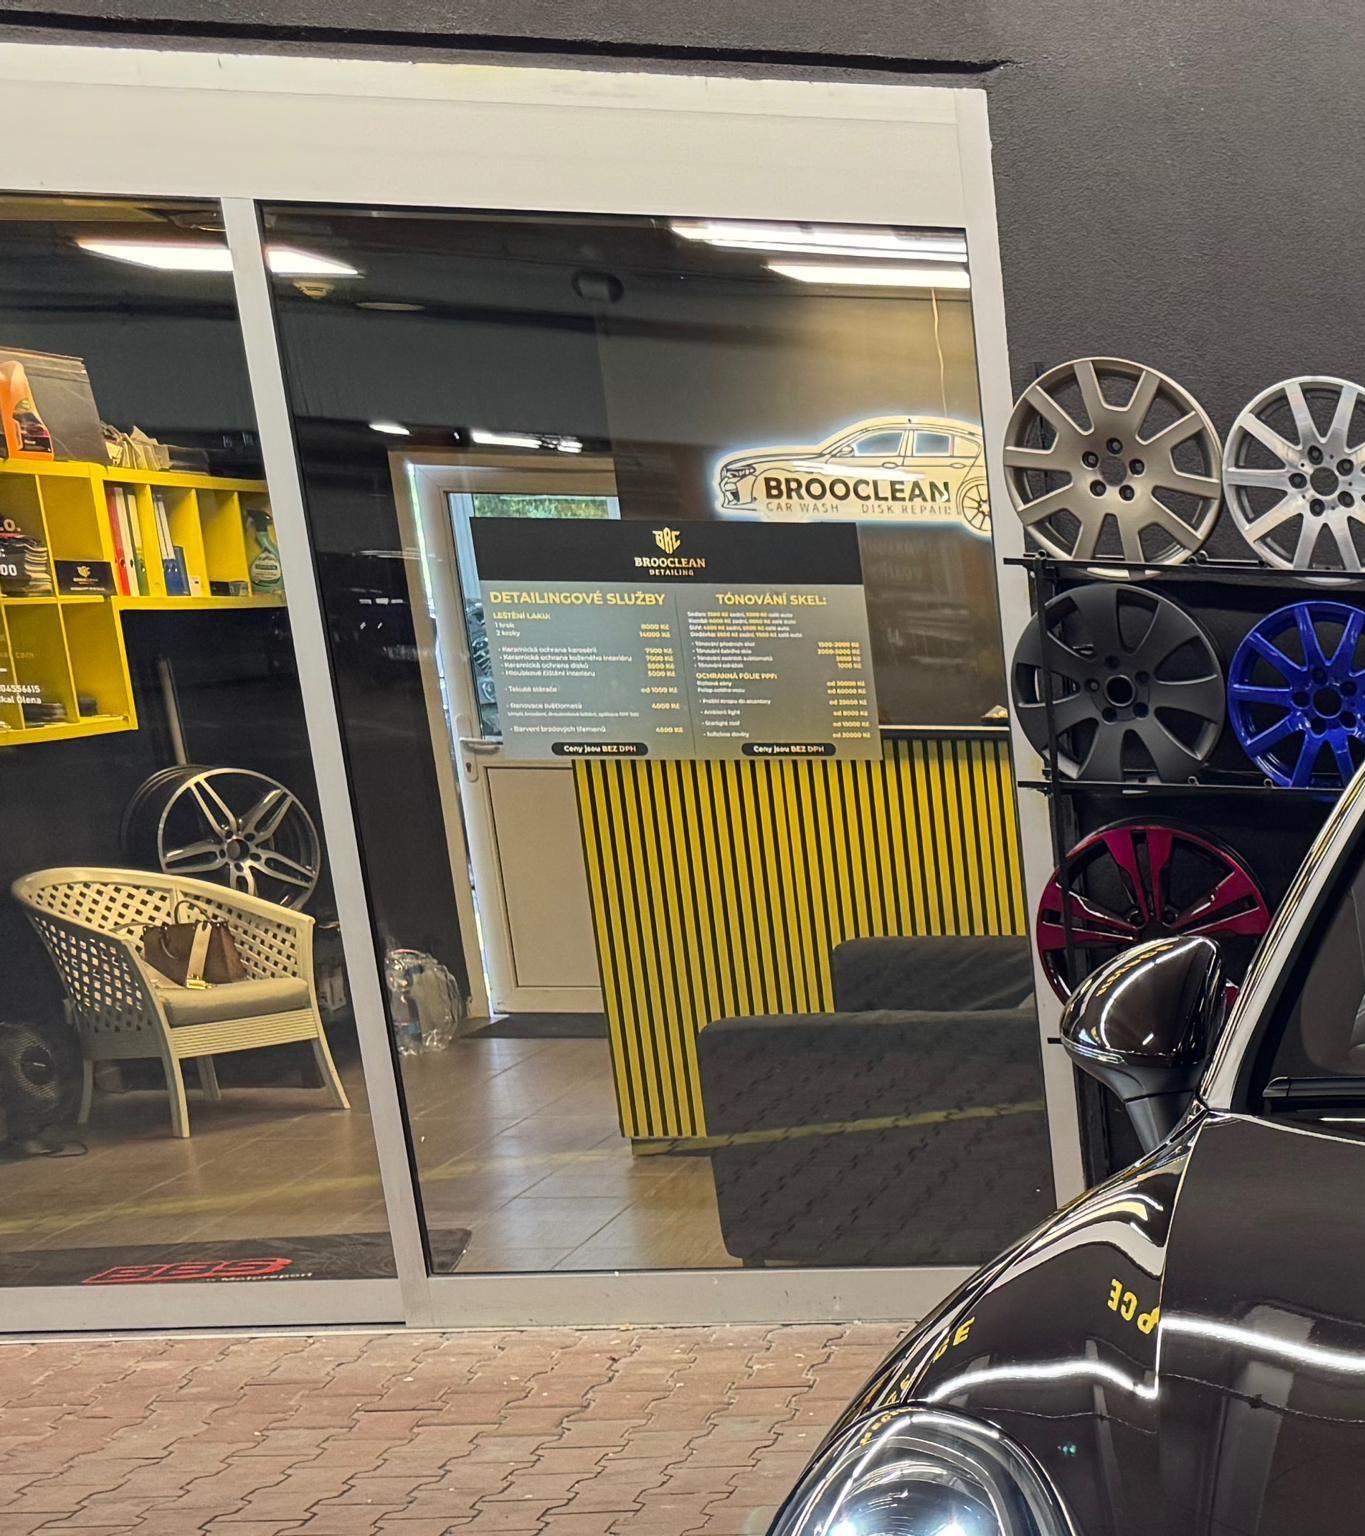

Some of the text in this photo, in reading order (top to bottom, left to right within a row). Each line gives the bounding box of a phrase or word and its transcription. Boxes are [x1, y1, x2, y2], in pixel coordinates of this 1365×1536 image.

[763, 476, 950, 504] BROOCLEAN
[766, 501, 793, 513] CAR
[799, 502, 839, 513] WASH
[861, 503, 895, 515] DISK
[634, 556, 706, 569] BROOCLEAN
[490, 591, 665, 606] DETAILINGOVÉ SLUŽBY
[716, 591, 827, 605] TÓNOVÁNÍ SKEL:
[563, 744, 583, 754] Ceny
[583, 744, 601, 753] jsou
[602, 745, 618, 753] BEZ
[753, 745, 772, 754] Ceny
[773, 745, 790, 754] jsou
